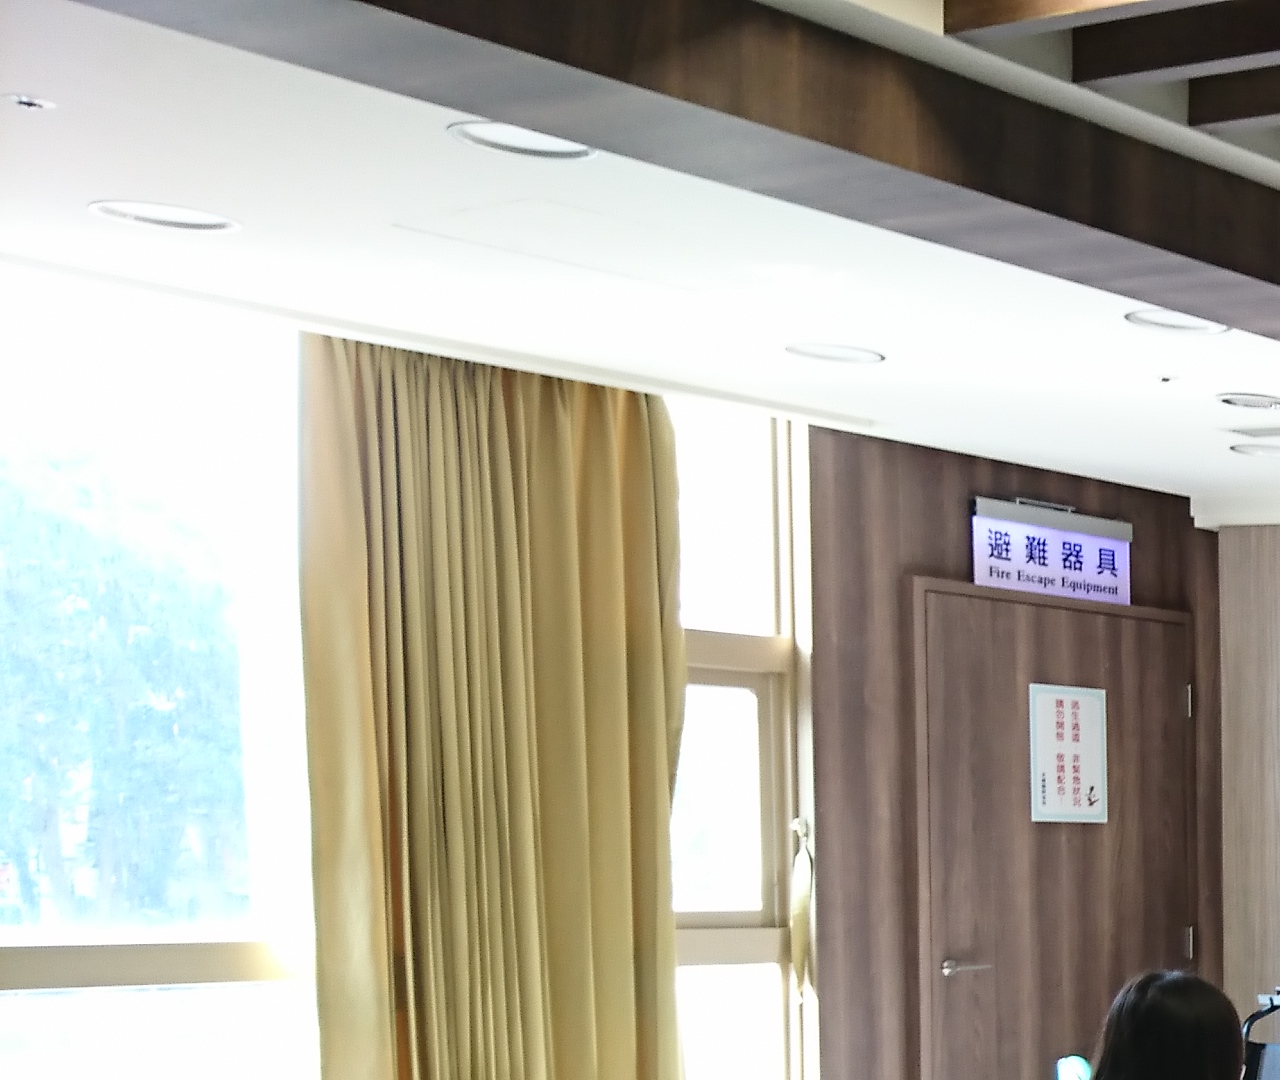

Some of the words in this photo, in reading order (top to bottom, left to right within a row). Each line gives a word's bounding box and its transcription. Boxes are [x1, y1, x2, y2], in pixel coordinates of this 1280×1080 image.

[988, 528, 1118, 577] 避難器具
[989, 565, 1011, 579] Fire
[1017, 570, 1056, 588] Escape
[1061, 576, 1118, 595] Equipment
